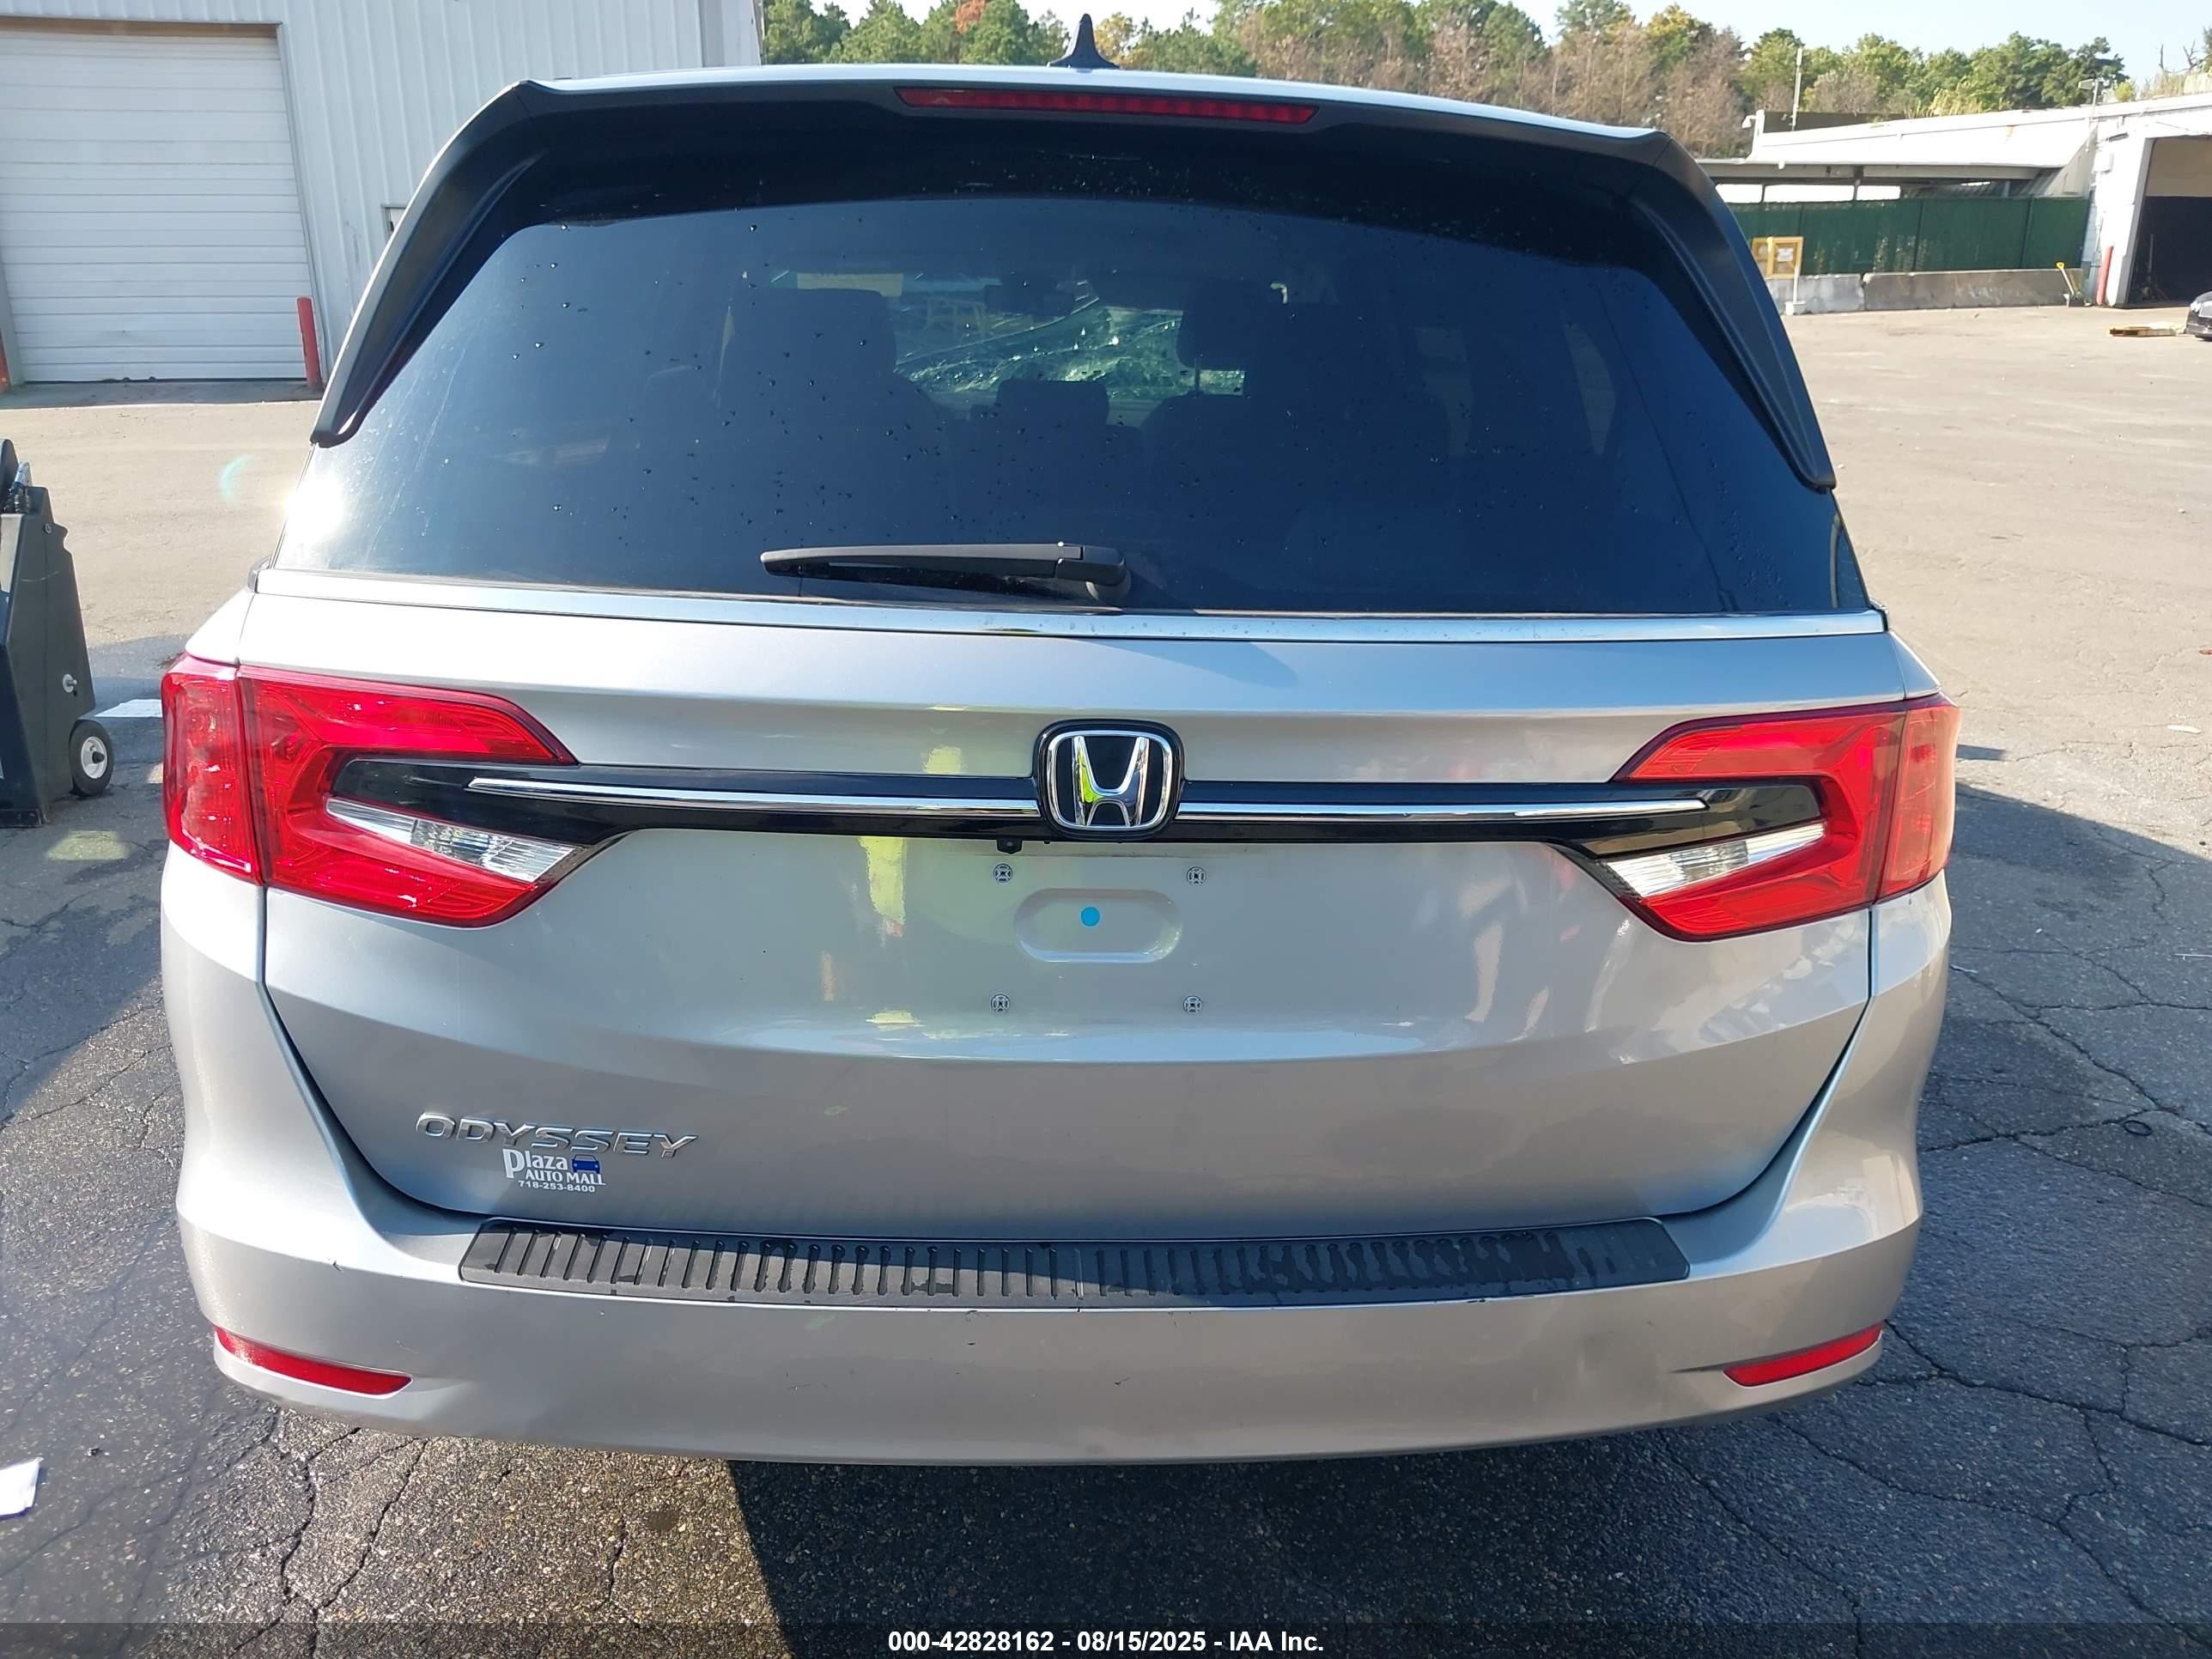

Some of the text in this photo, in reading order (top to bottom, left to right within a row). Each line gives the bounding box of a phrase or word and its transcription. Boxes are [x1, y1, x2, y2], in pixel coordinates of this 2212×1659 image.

[416, 1112, 698, 1158] ODYSSEY
[501, 1148, 569, 1180] Plaza
[518, 1180, 596, 1193] 718-253-8400
[525, 1170, 606, 1186] AUTO MALL
